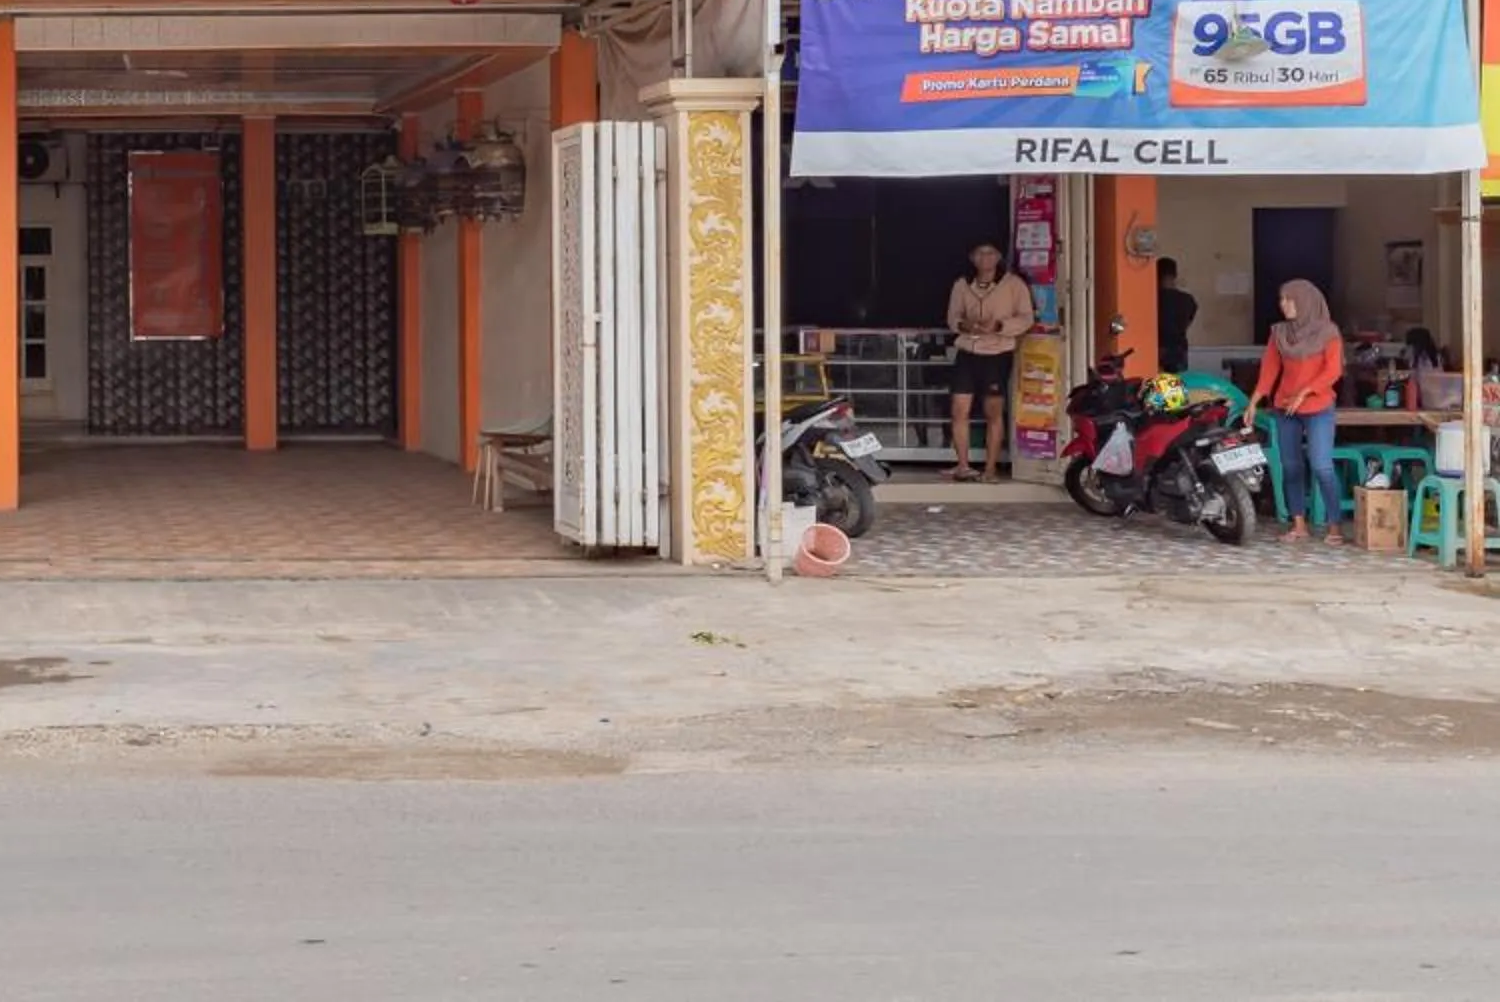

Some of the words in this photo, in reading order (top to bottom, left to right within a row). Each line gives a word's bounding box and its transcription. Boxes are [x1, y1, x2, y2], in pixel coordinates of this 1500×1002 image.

[920, 23, 1020, 56] Harga
[1027, 18, 1132, 50] Sama!
[923, 79, 965, 91] Promo
[966, 77, 1007, 89] Kartu
[1011, 75, 1070, 88] Perdana
[1203, 68, 1228, 84] 65
[1233, 68, 1269, 84] Ribu
[1277, 67, 1305, 83] 30
[1309, 69, 1339, 83] Hari
[1015, 138, 1119, 163] RIFAL
[1133, 139, 1228, 165] CELL
